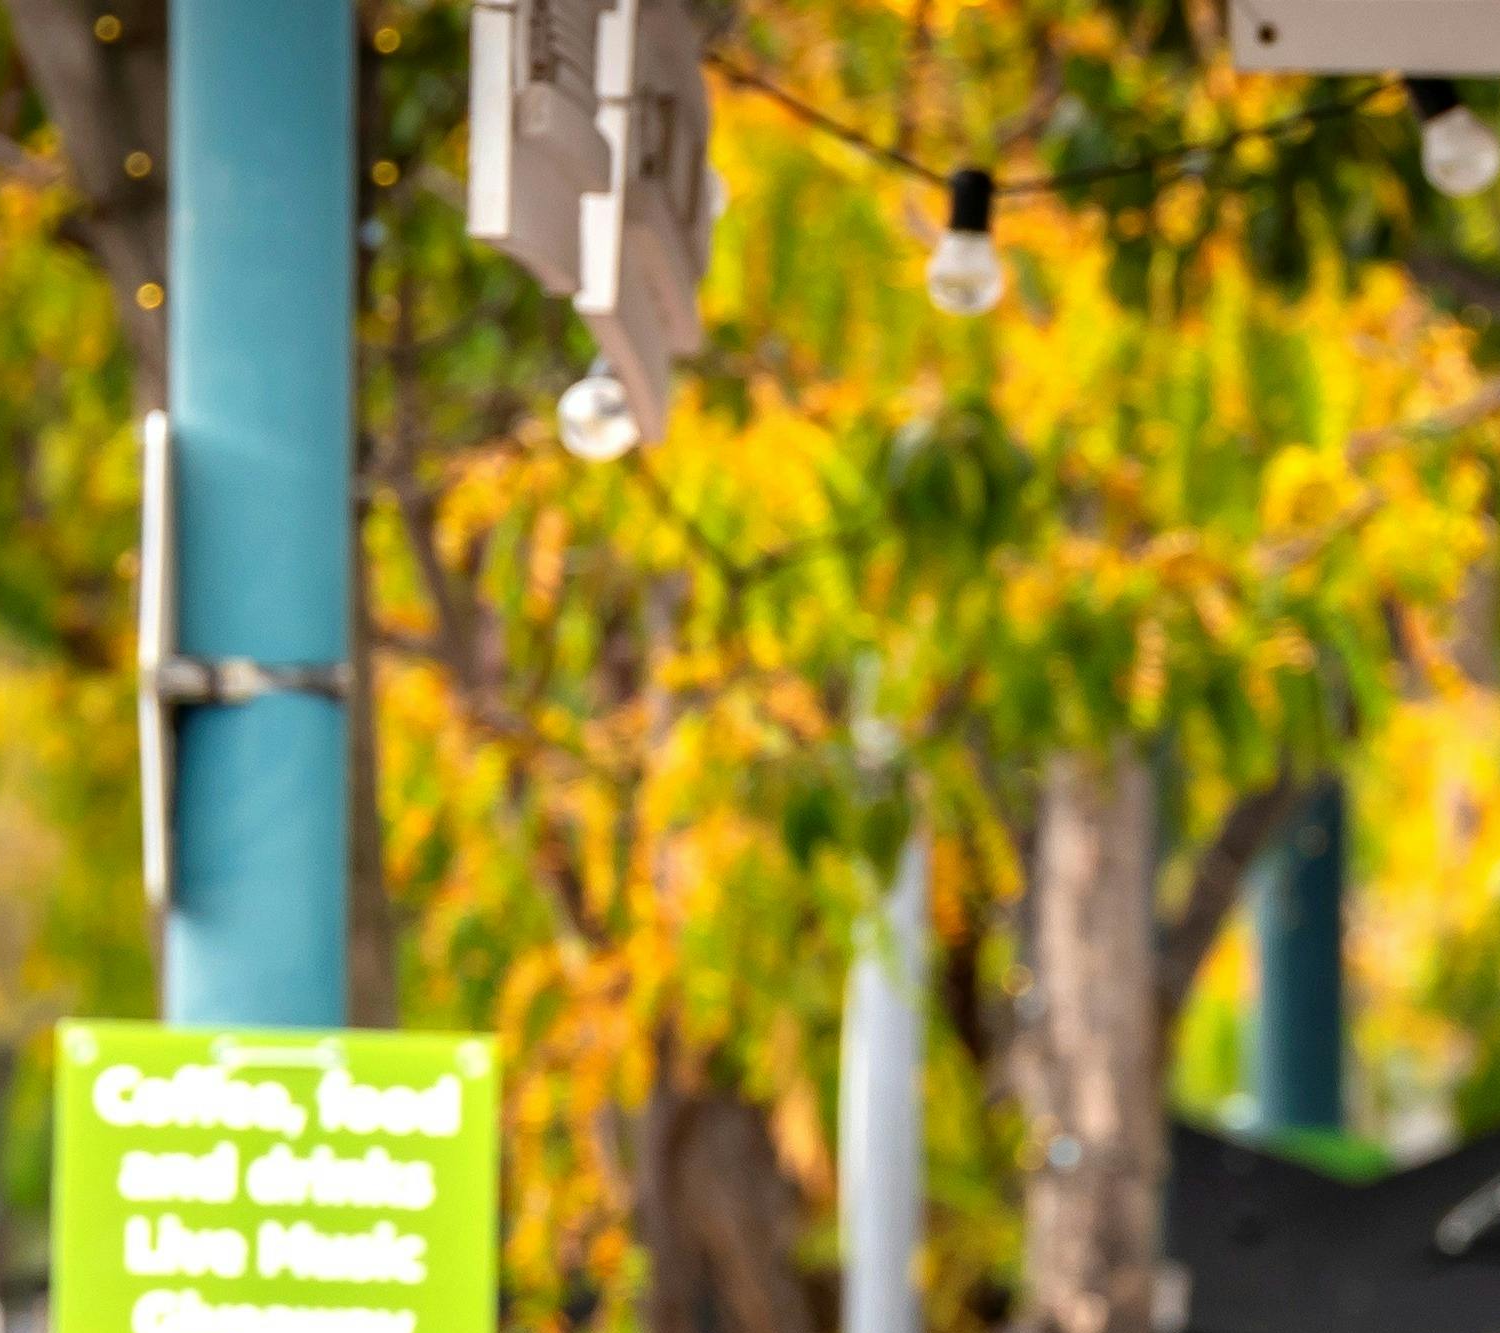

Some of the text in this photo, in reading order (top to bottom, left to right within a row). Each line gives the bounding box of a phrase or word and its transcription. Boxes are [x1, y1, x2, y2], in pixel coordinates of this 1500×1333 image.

[319, 1070, 461, 1135] food
[119, 1143, 433, 1208] and drinks
[126, 1215, 425, 1282] Live Music
